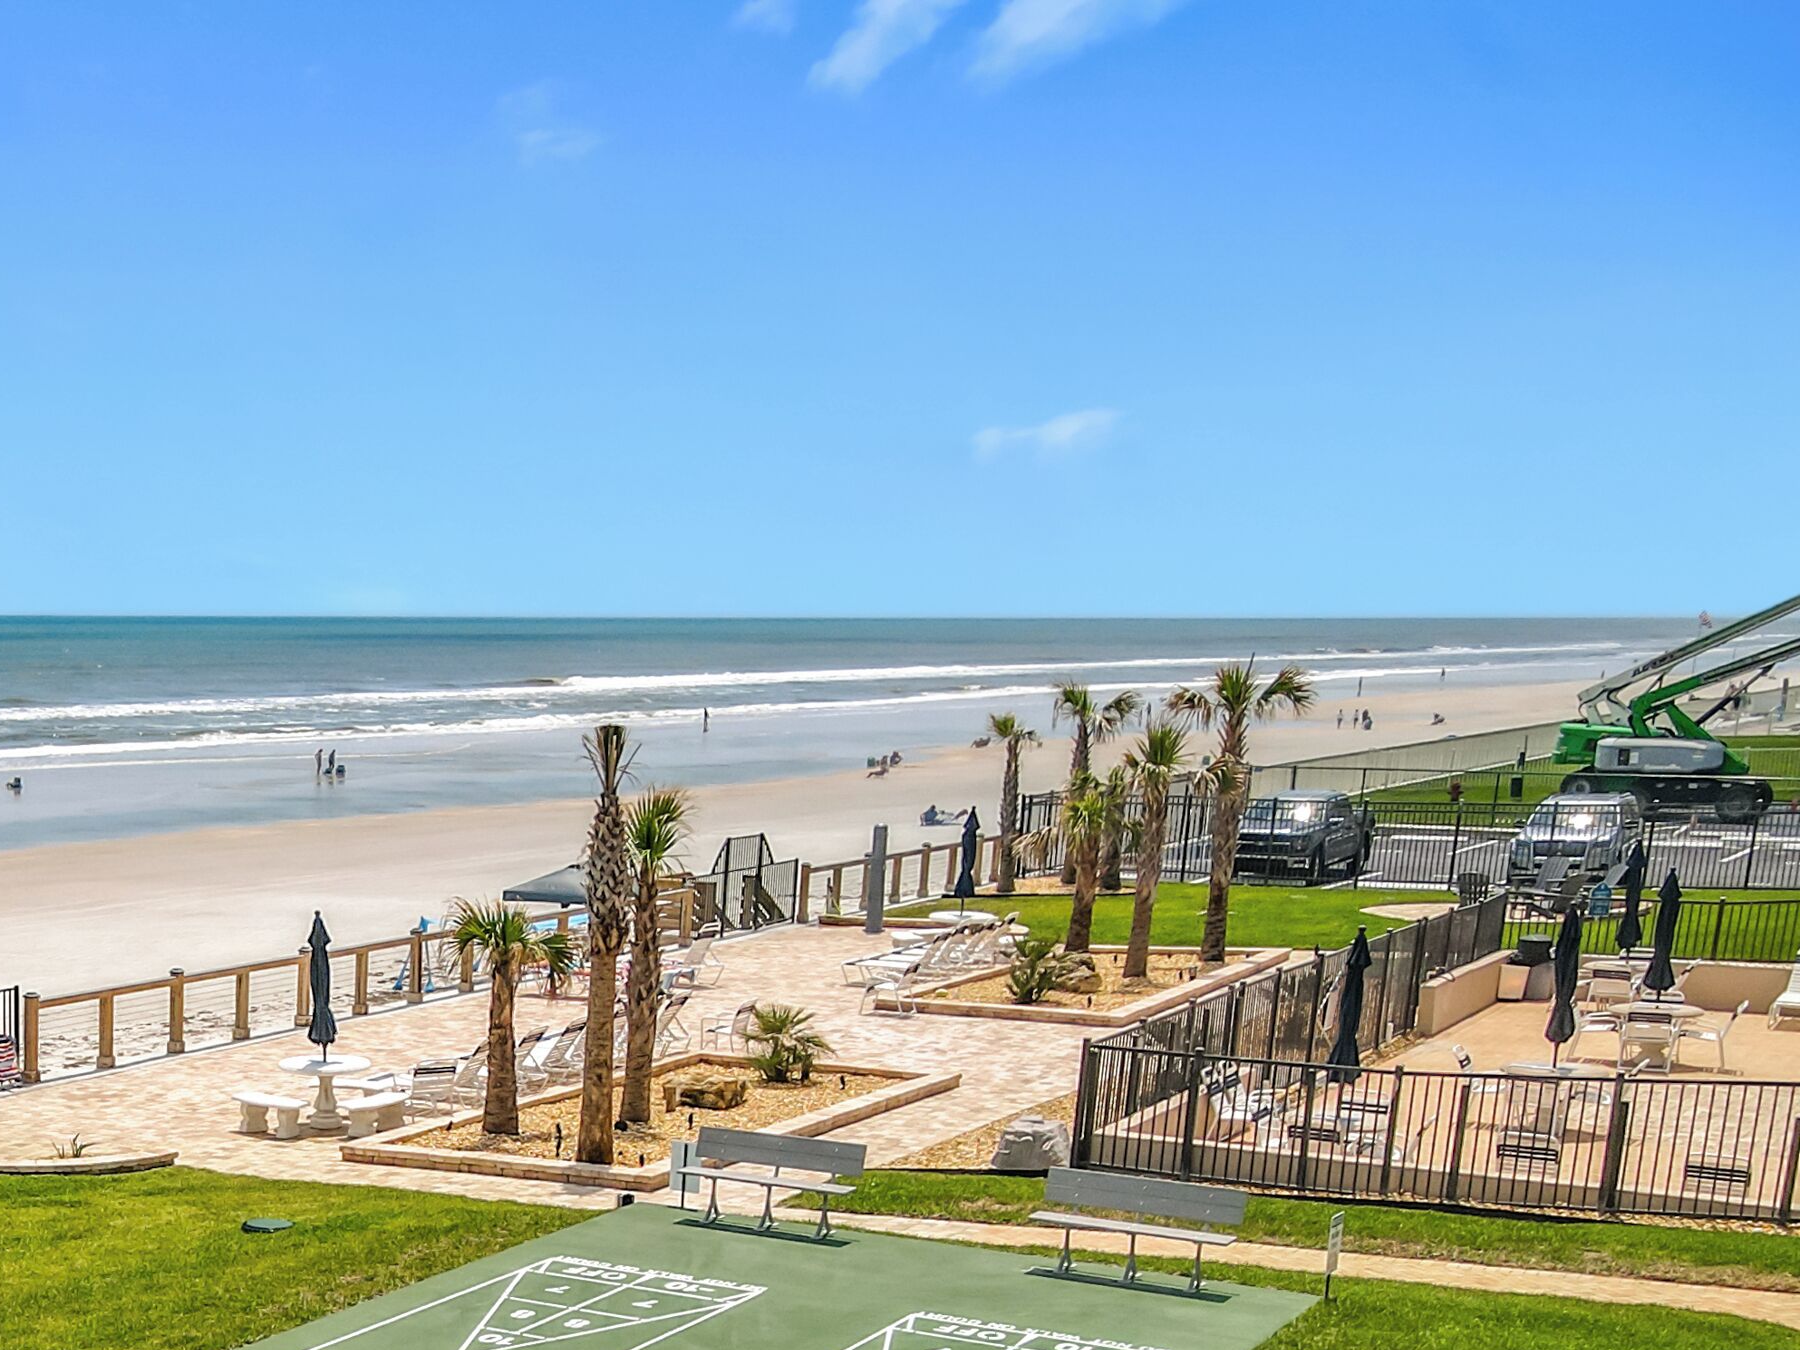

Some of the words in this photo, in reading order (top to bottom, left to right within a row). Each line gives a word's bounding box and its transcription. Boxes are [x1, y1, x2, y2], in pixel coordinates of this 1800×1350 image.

[562, 1266, 628, 1281] OFF
[544, 1285, 571, 1294] 7
[663, 1281, 715, 1293] -10
[631, 1299, 659, 1309] 7
[563, 1318, 591, 1329] 8
[932, 1324, 1007, 1341] OFF
[478, 1333, 515, 1346] 10
